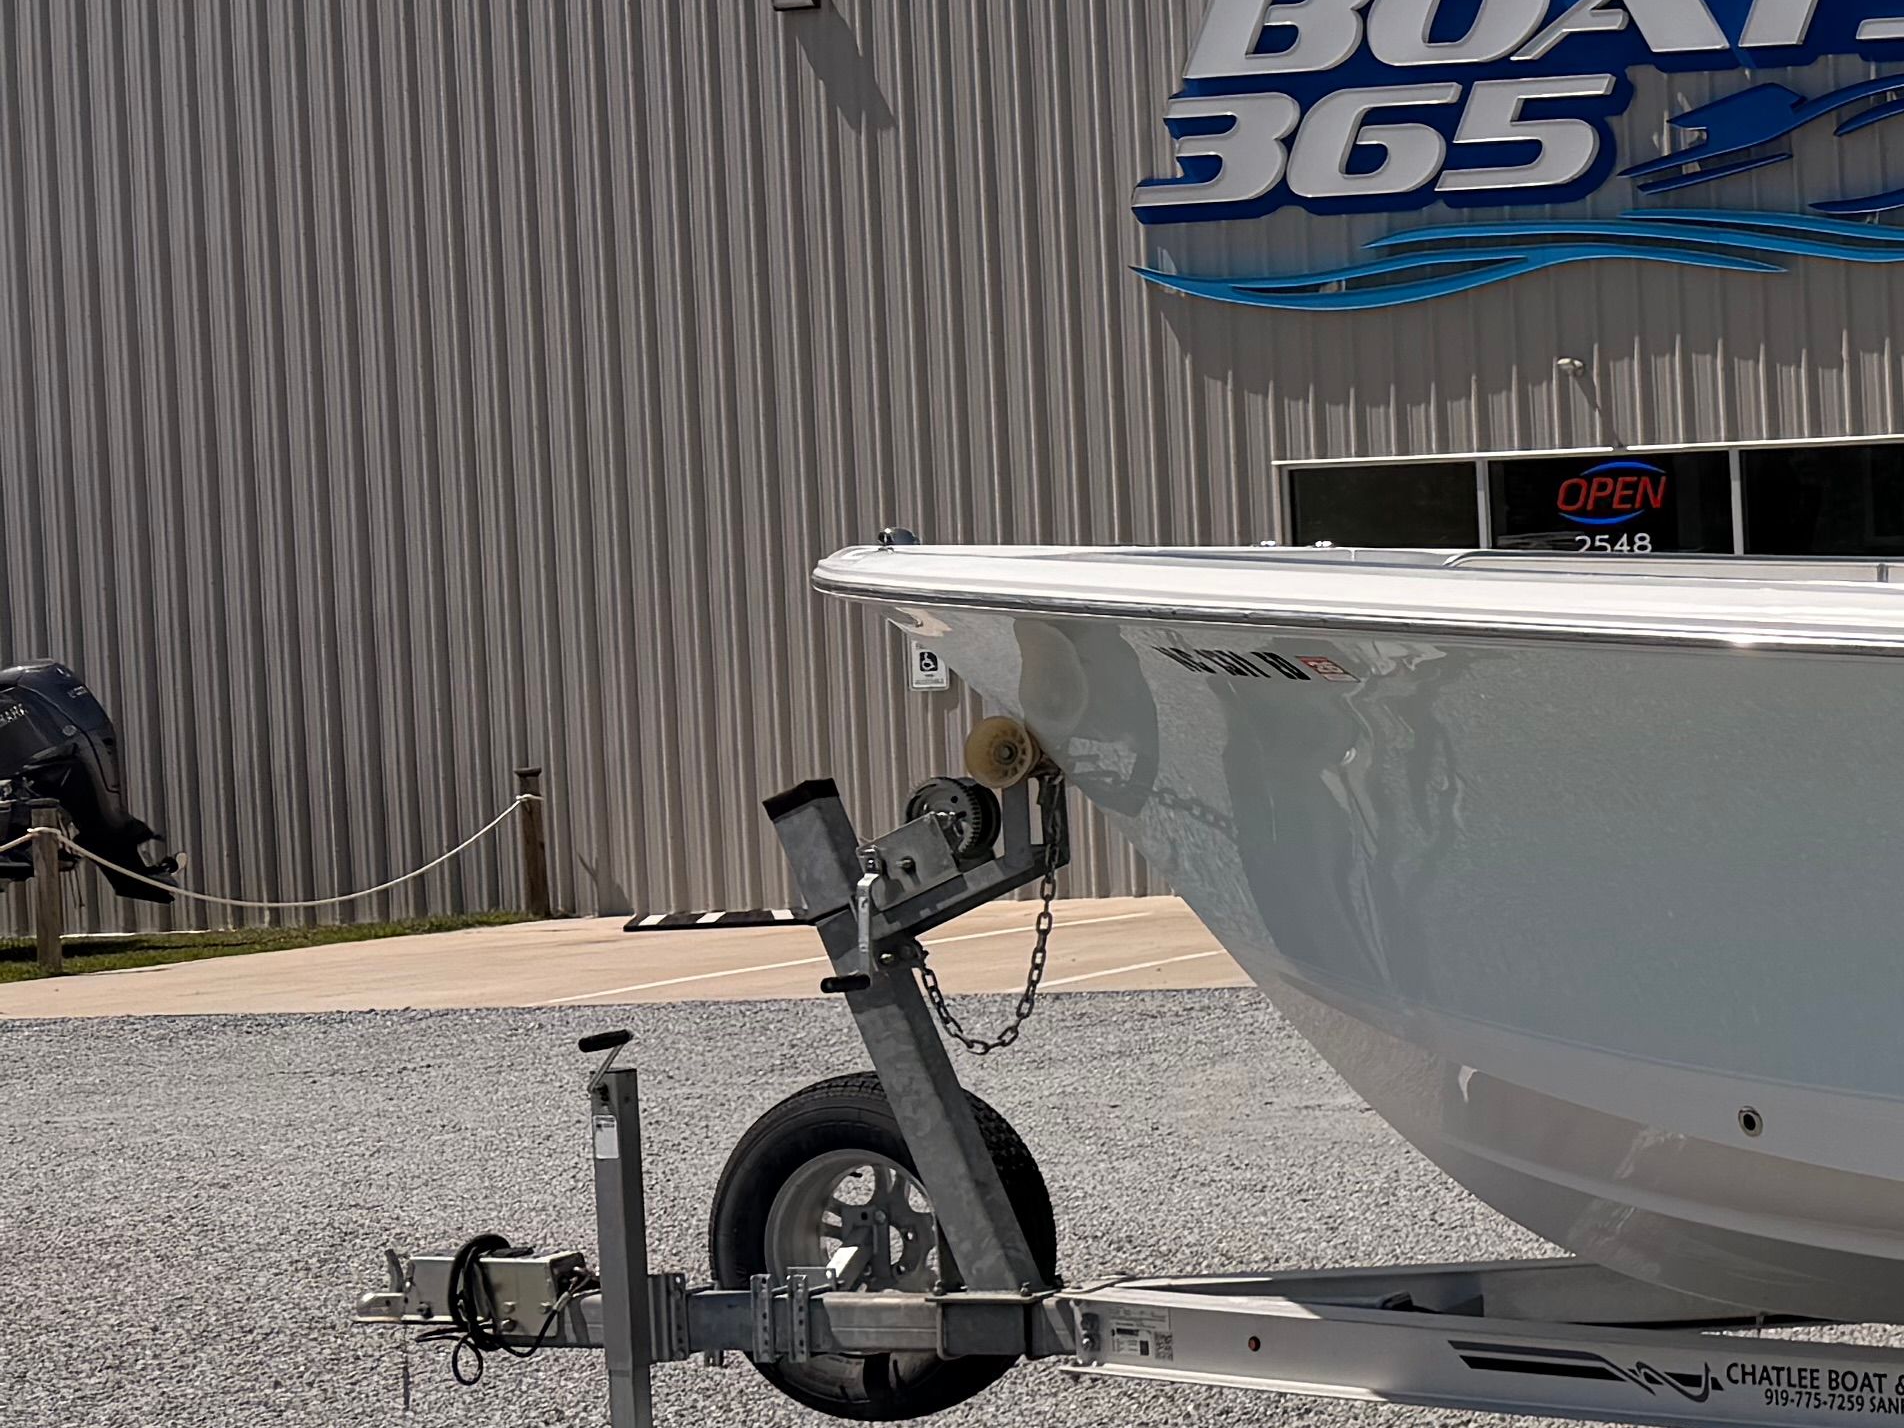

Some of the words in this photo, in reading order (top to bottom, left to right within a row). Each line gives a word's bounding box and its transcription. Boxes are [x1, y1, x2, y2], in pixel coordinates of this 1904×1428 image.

[1131, 73, 1616, 208] 365
[1556, 475, 1667, 511] OPEN
[1575, 532, 1653, 553] 2548
[1725, 1361, 1820, 1390] CHATLEE
[1827, 1368, 1888, 1395] BOAT
[1764, 1389, 1865, 1412] 919-775-7259
